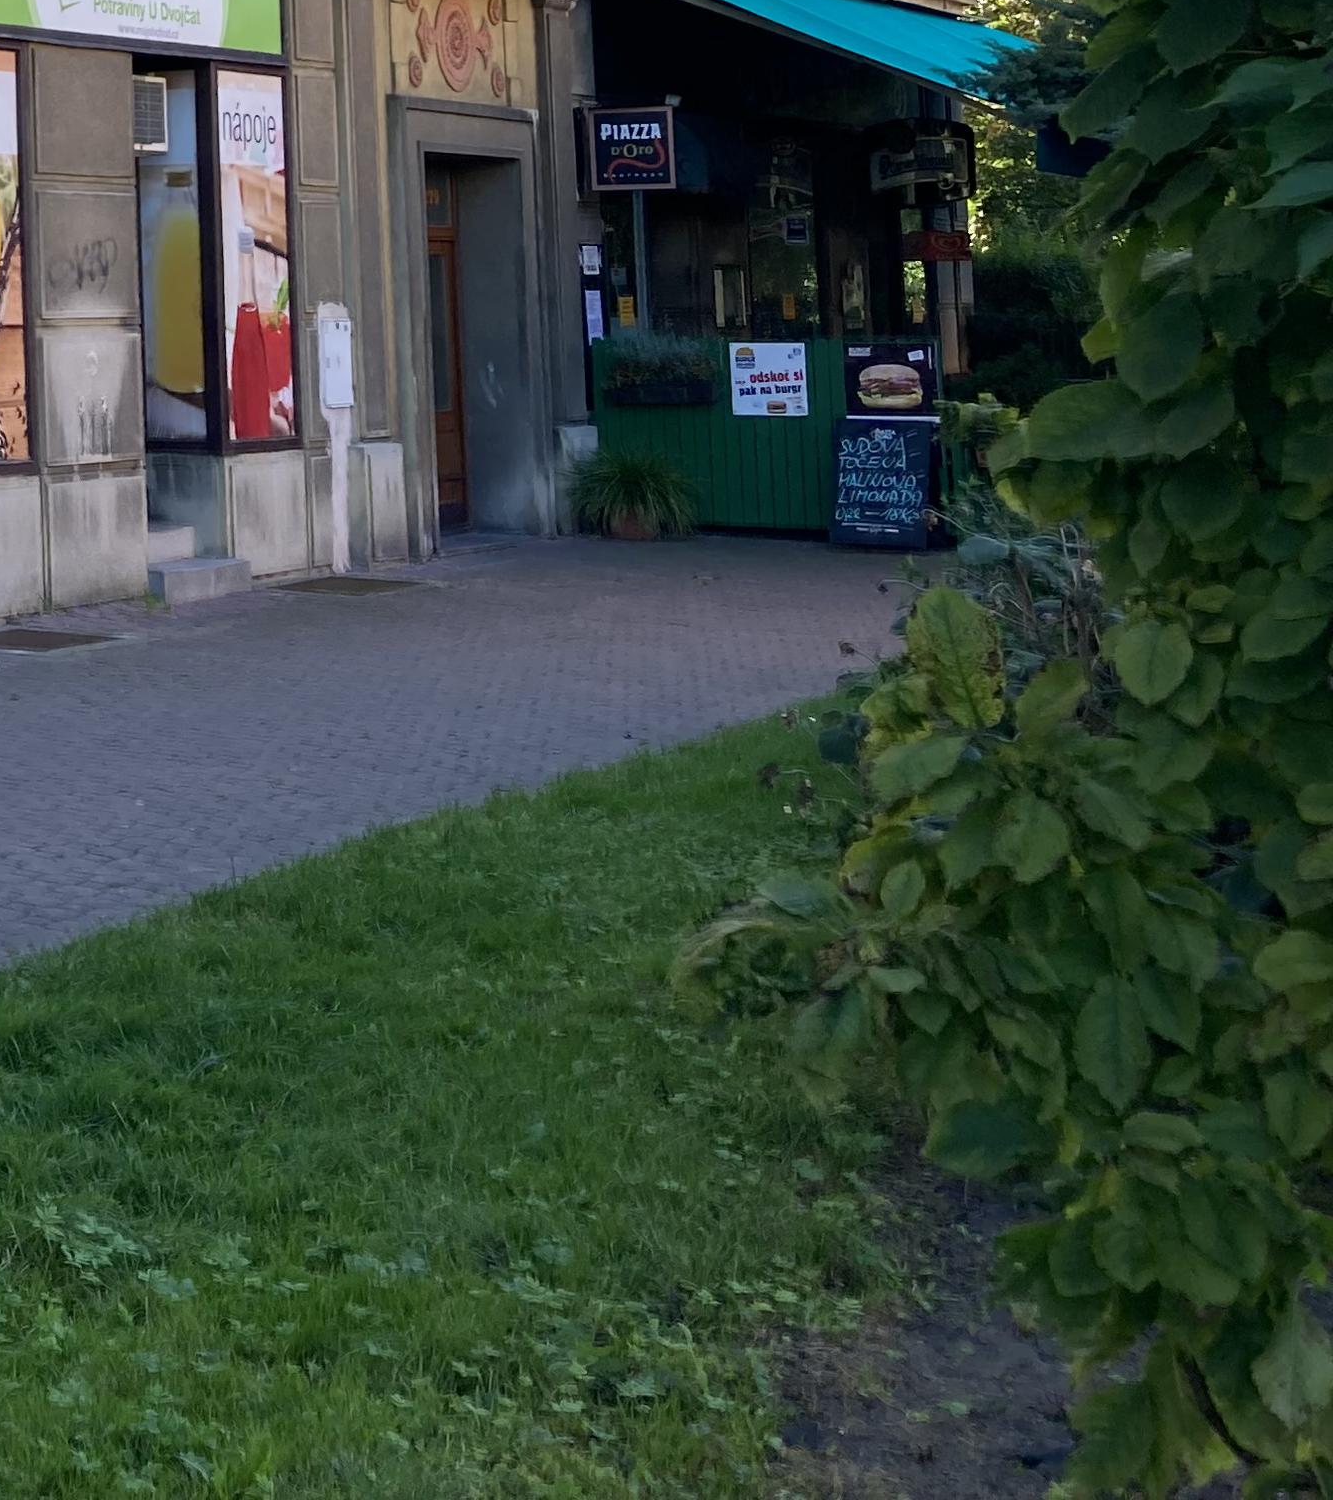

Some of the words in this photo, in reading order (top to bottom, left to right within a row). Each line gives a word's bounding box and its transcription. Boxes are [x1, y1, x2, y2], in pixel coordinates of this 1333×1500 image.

[149, 1, 157, 19] U
[160, 4, 201, 27] Dvojčat
[221, 106, 276, 154] nápoje
[600, 123, 661, 140] PIAZZA
